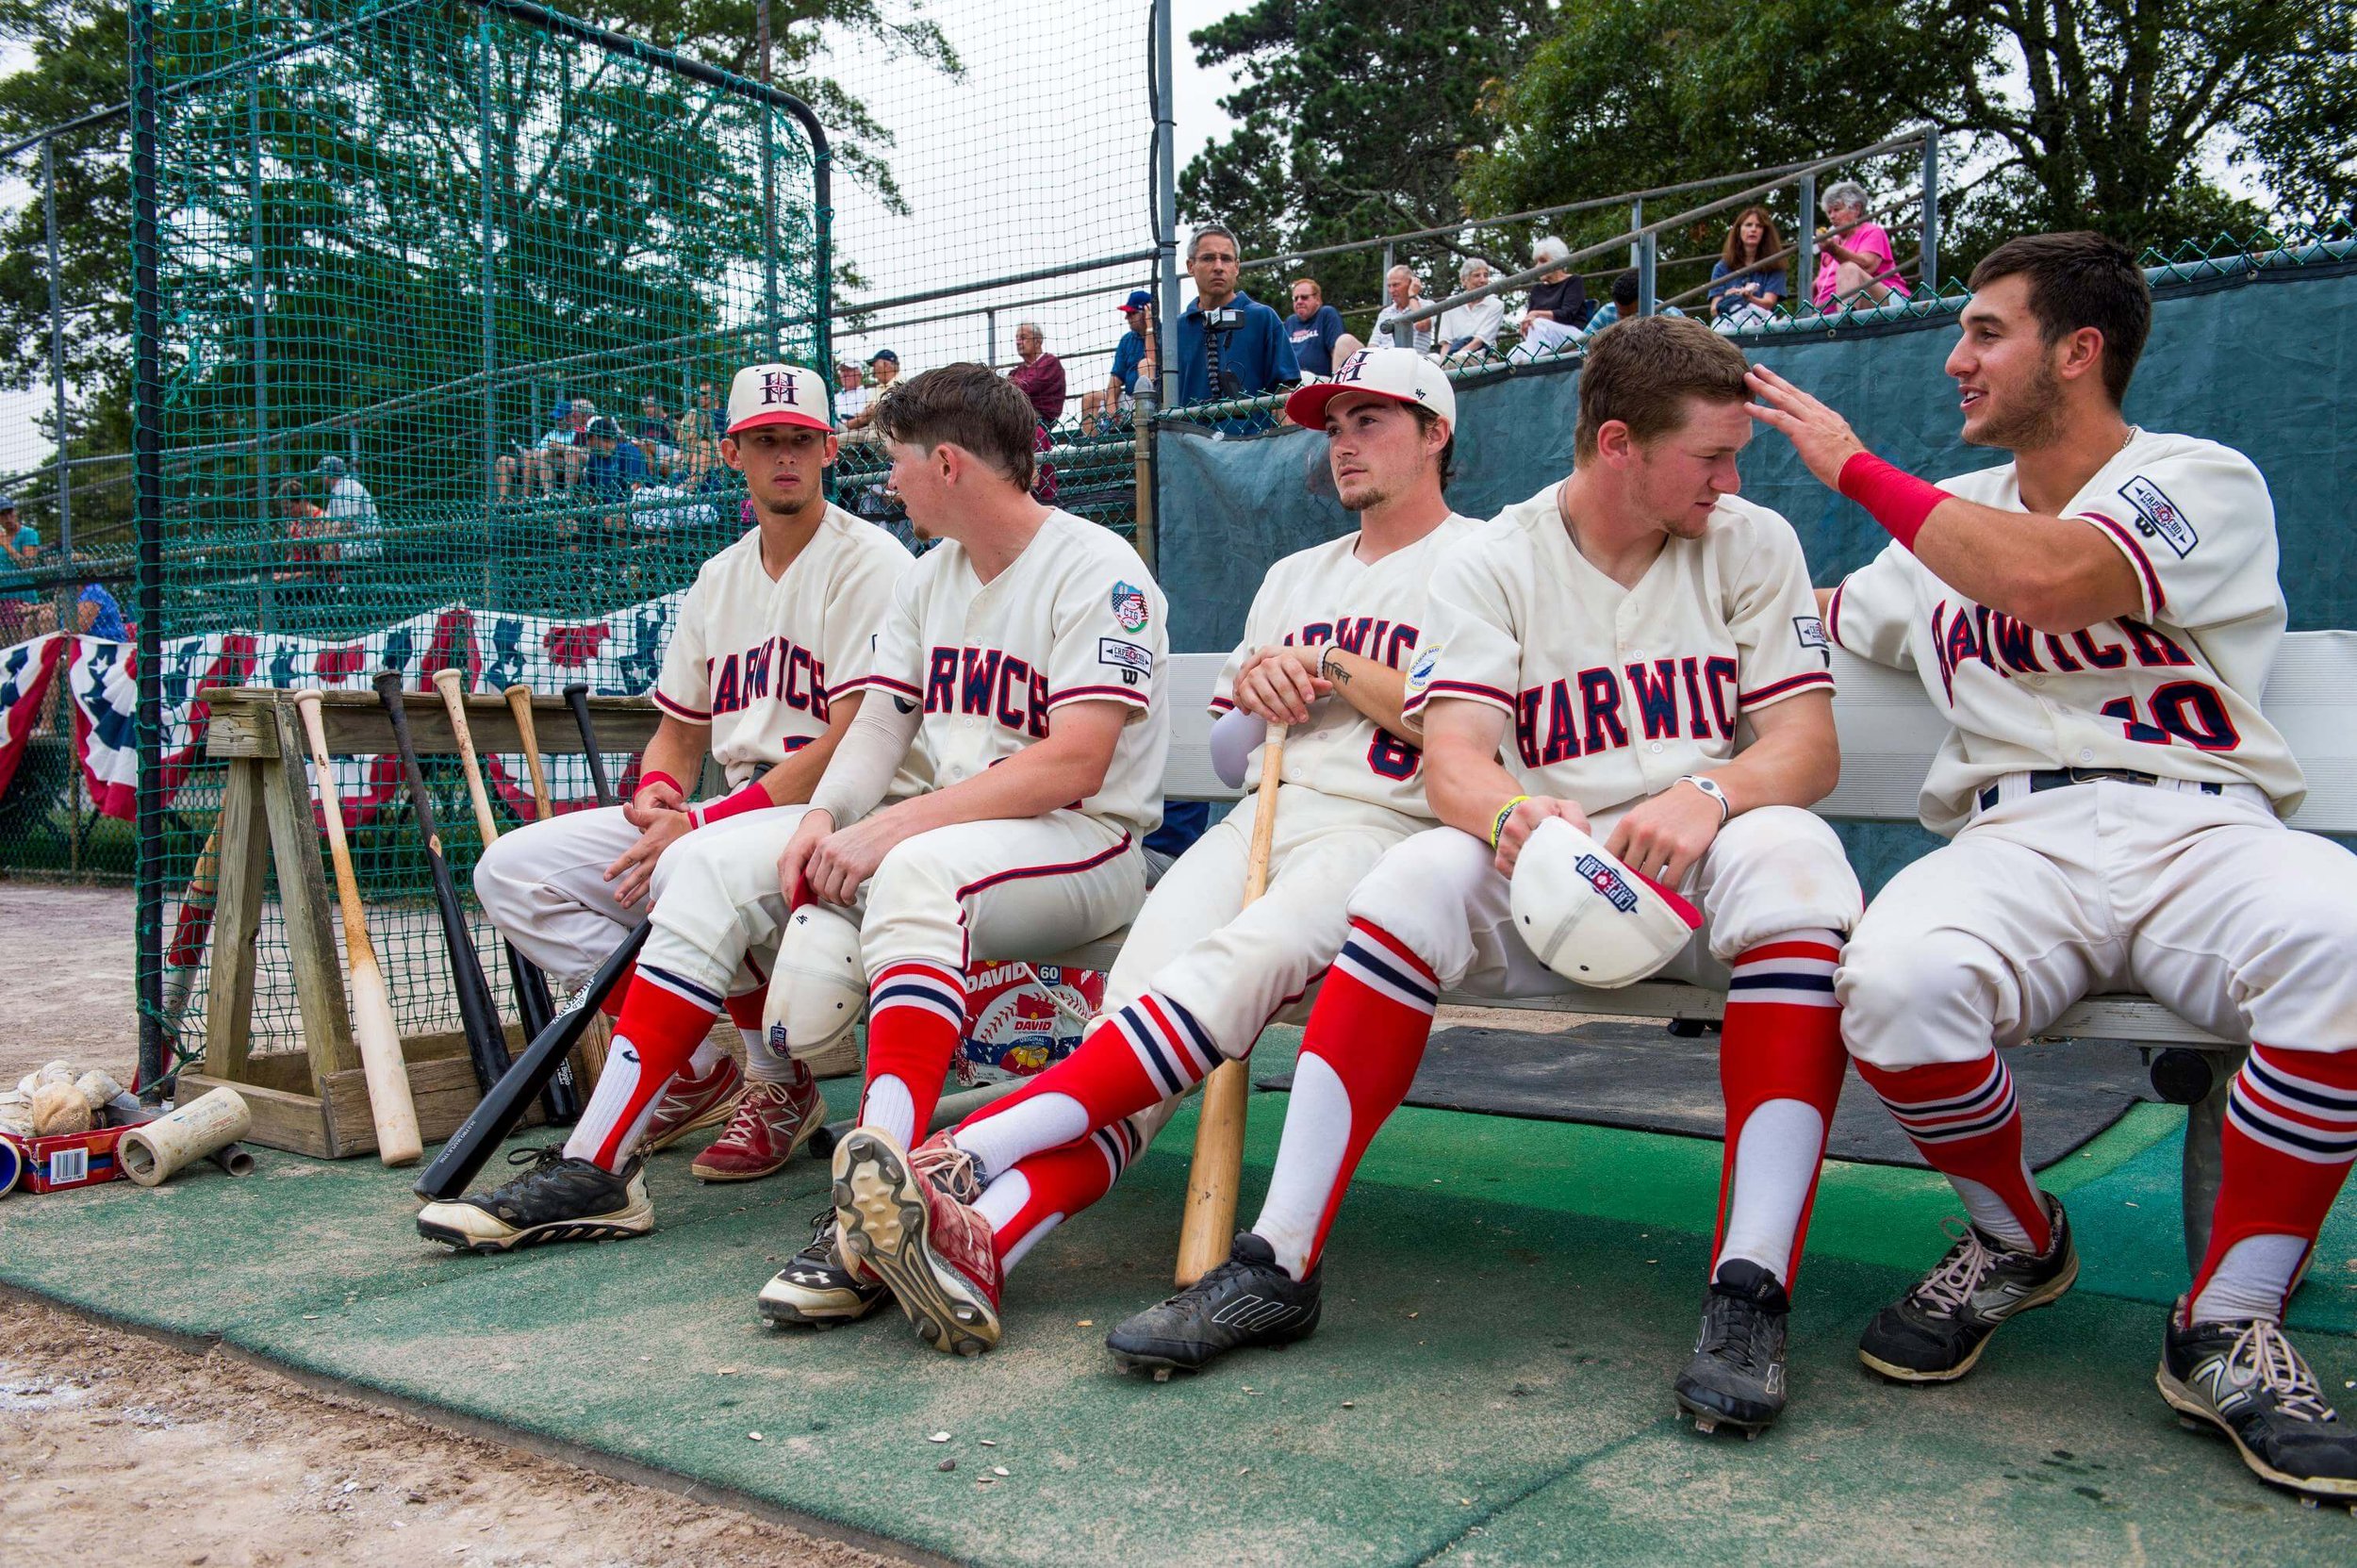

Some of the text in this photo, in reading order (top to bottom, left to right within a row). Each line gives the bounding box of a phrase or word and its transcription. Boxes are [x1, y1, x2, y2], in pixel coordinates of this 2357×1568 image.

[760, 371, 799, 405] H
[2142, 490, 2164, 512] CAPE
[1124, 608, 1139, 620] CTG
[706, 635, 831, 725] ARWICH
[2100, 680, 2241, 751] 10
[1367, 727, 1425, 782] 8
[1577, 858, 1632, 909] CAPE COD
[966, 962, 1028, 994] DAVID
[1040, 966, 1059, 980] 60
[572, 997, 585, 1009] OLD
[1014, 1020, 1052, 1031] DAVID
